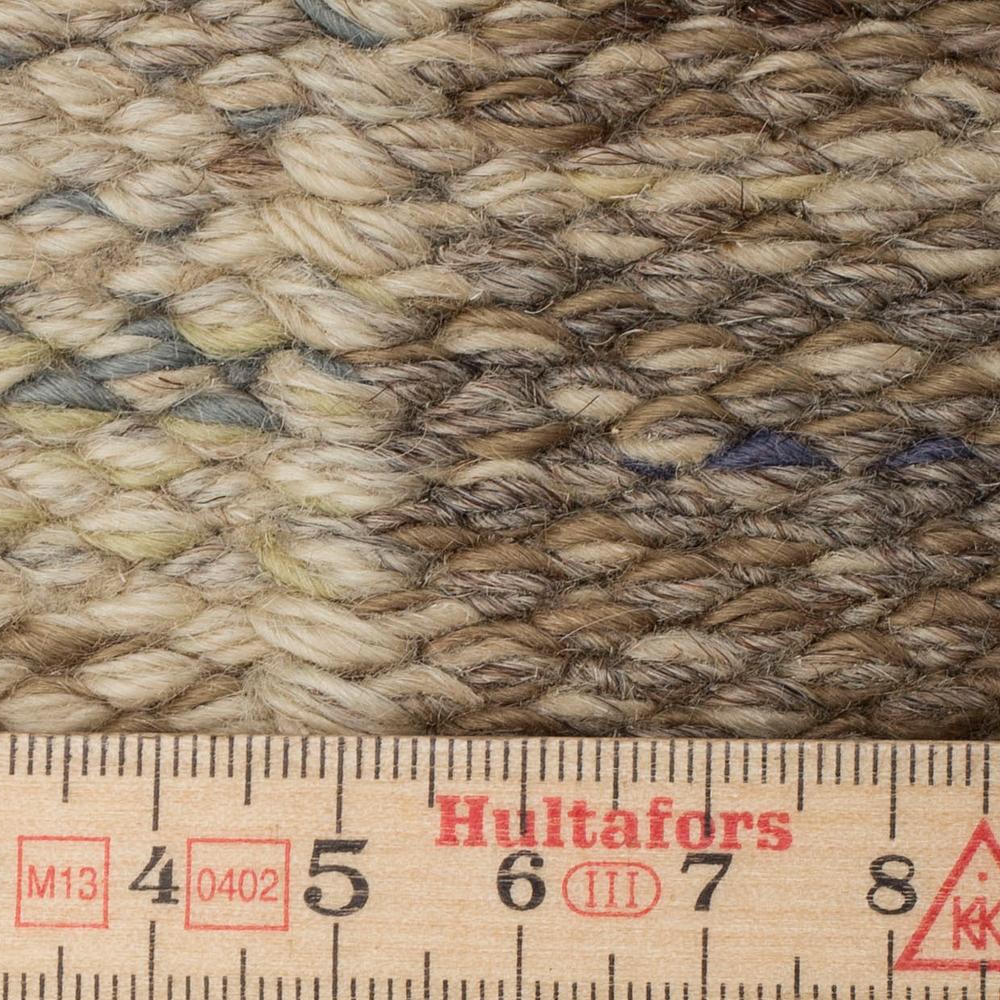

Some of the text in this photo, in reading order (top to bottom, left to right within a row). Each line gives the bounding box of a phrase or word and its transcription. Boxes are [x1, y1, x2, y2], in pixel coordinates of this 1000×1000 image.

[435, 795, 794, 852] Hultafors
[26, 864, 98, 900] M13
[128, 845, 180, 905] 4
[196, 867, 279, 902] 0402
[302, 838, 370, 918] 5
[496, 849, 547, 912] 6
[585, 870, 638, 909] III
[680, 852, 734, 912] 7
[866, 854, 918, 916] 8
